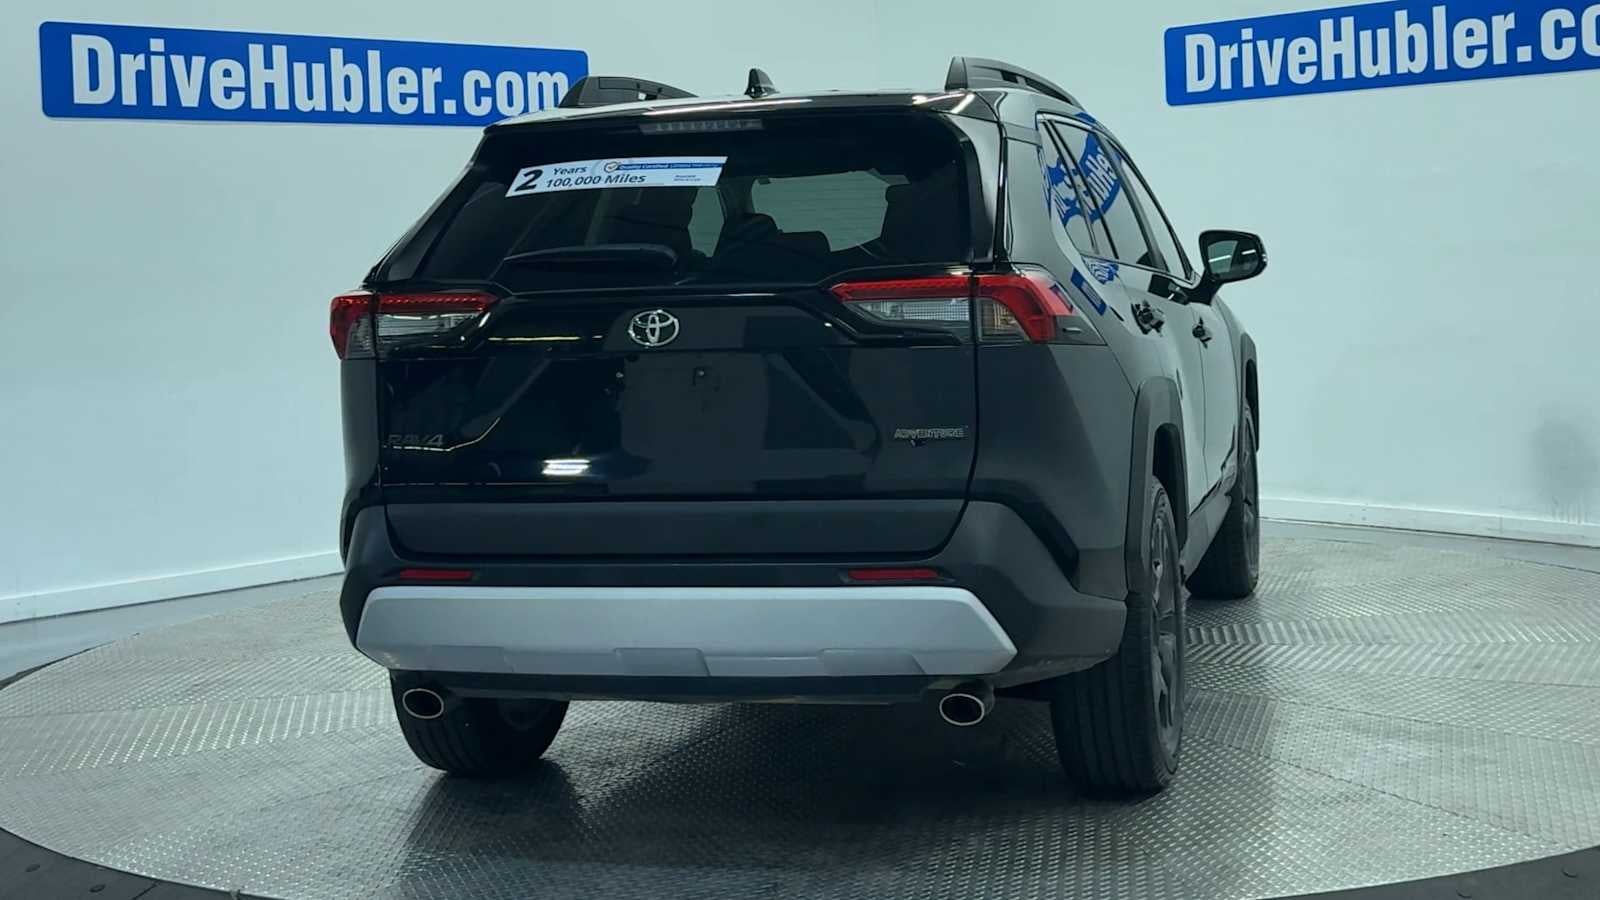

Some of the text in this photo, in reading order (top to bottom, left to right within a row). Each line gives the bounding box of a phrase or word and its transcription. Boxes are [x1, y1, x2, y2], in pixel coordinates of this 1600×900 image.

[70, 33, 569, 116] DriveHubler.com
[553, 166, 588, 175] Years
[514, 169, 544, 192] 2
[546, 173, 647, 188] 100,000 Miles
